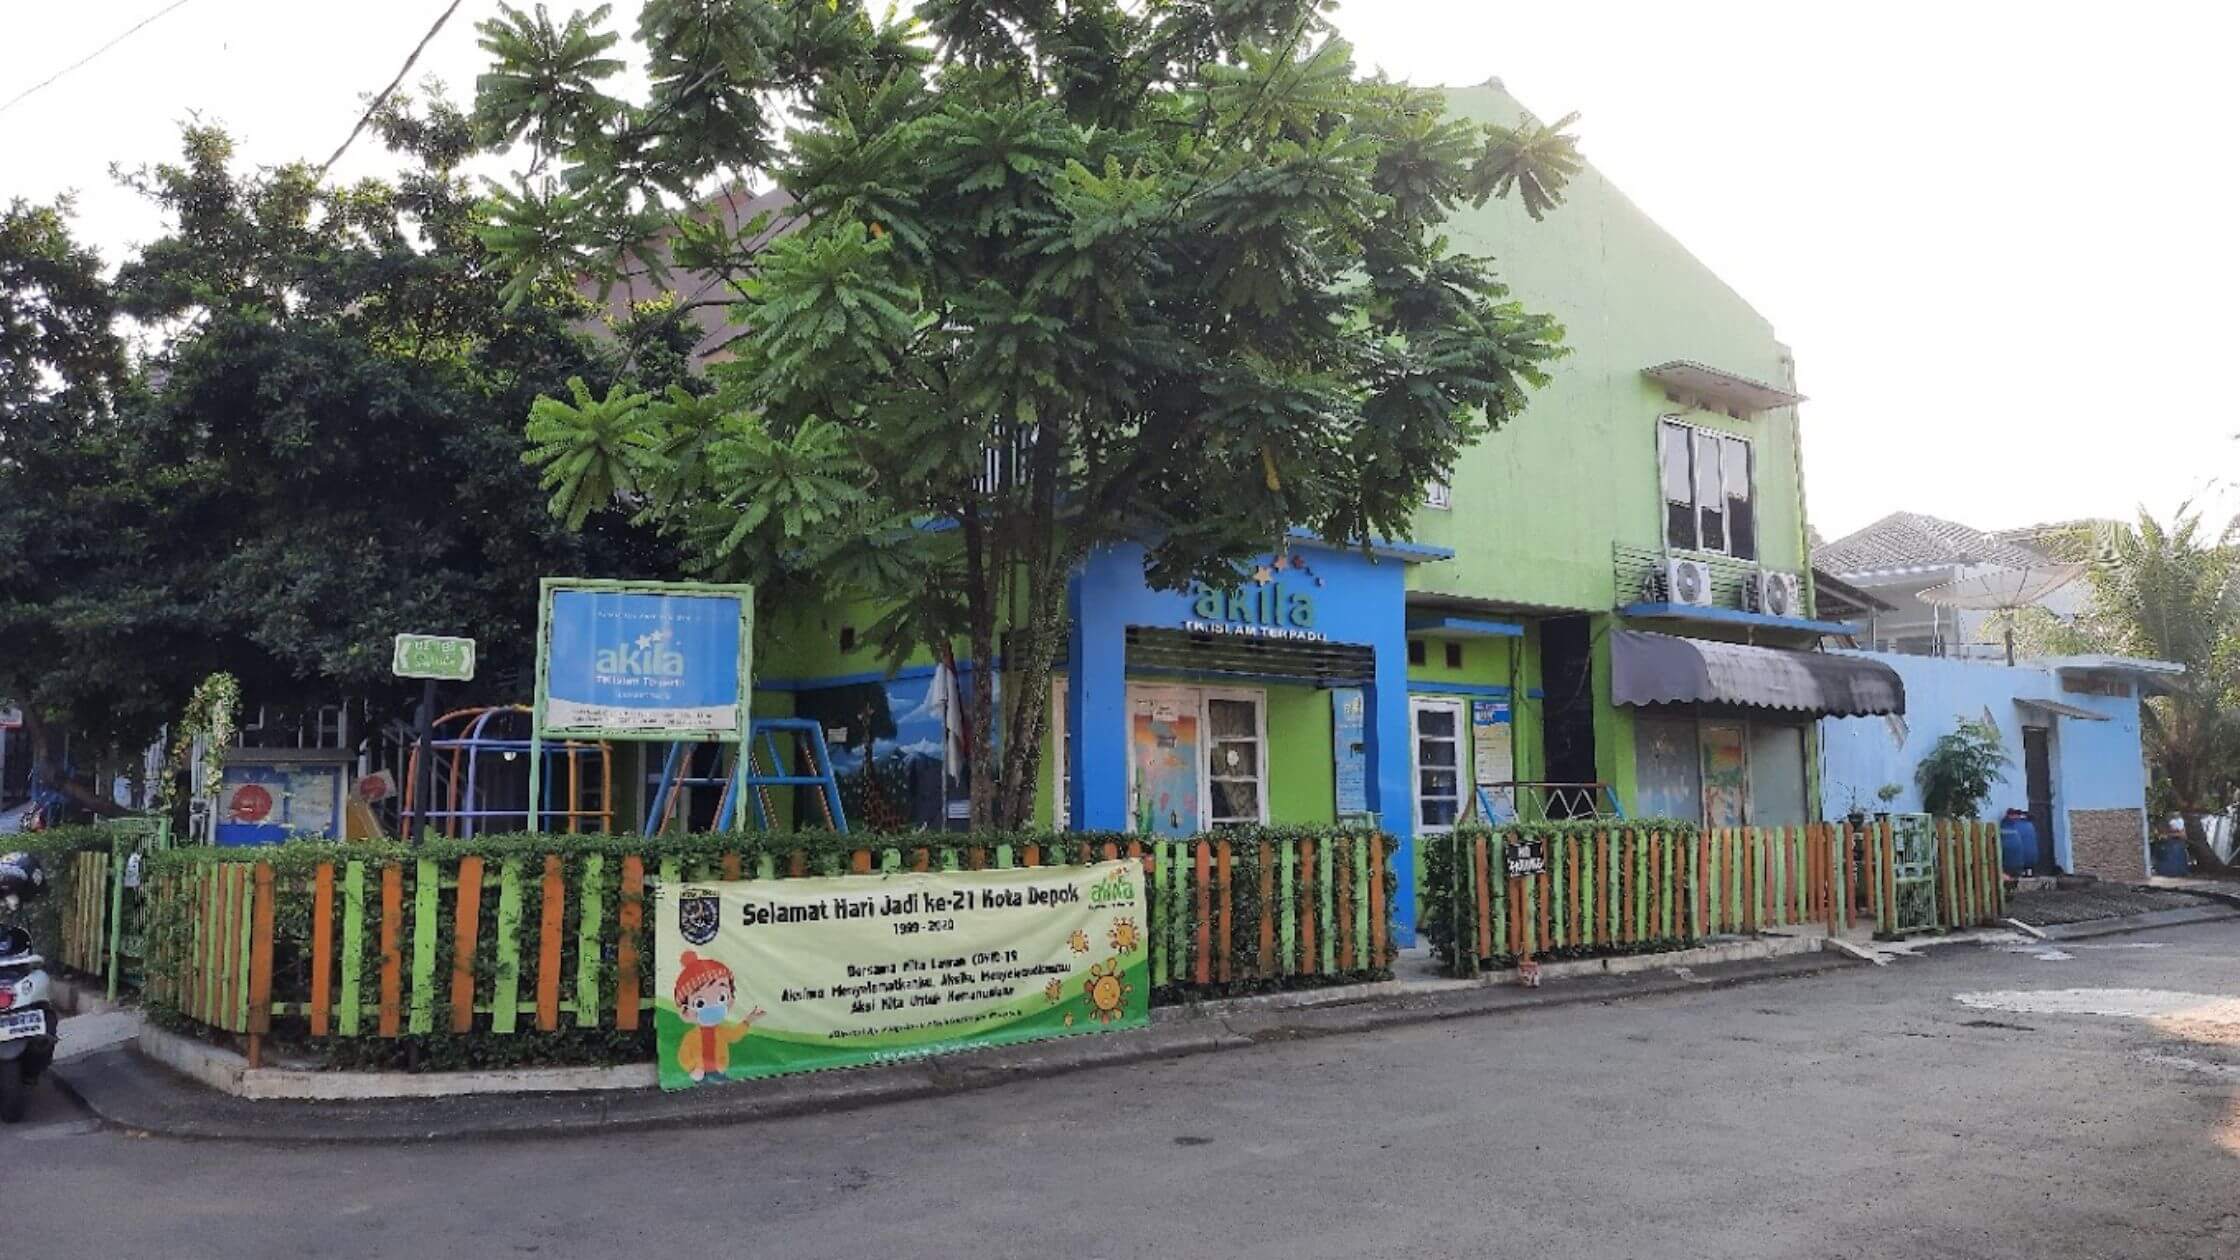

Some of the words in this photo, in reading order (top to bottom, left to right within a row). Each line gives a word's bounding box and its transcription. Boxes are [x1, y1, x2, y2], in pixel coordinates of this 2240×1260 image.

[1194, 580, 1314, 628] akila
[1260, 626, 1328, 641] TERPADU
[596, 642, 685, 676] akila
[743, 901, 829, 926] Selamat
[835, 896, 875, 919] Hari
[880, 892, 918, 916] Jadi
[924, 889, 974, 913] ke-21
[982, 887, 1022, 909] Kota
[1027, 883, 1080, 908] Depok
[893, 922, 919, 935] 1999
[928, 918, 954, 932] 2020
[847, 963, 896, 978] Bersama
[931, 958, 966, 970] Lawan
[850, 998, 875, 1015] Aksi
